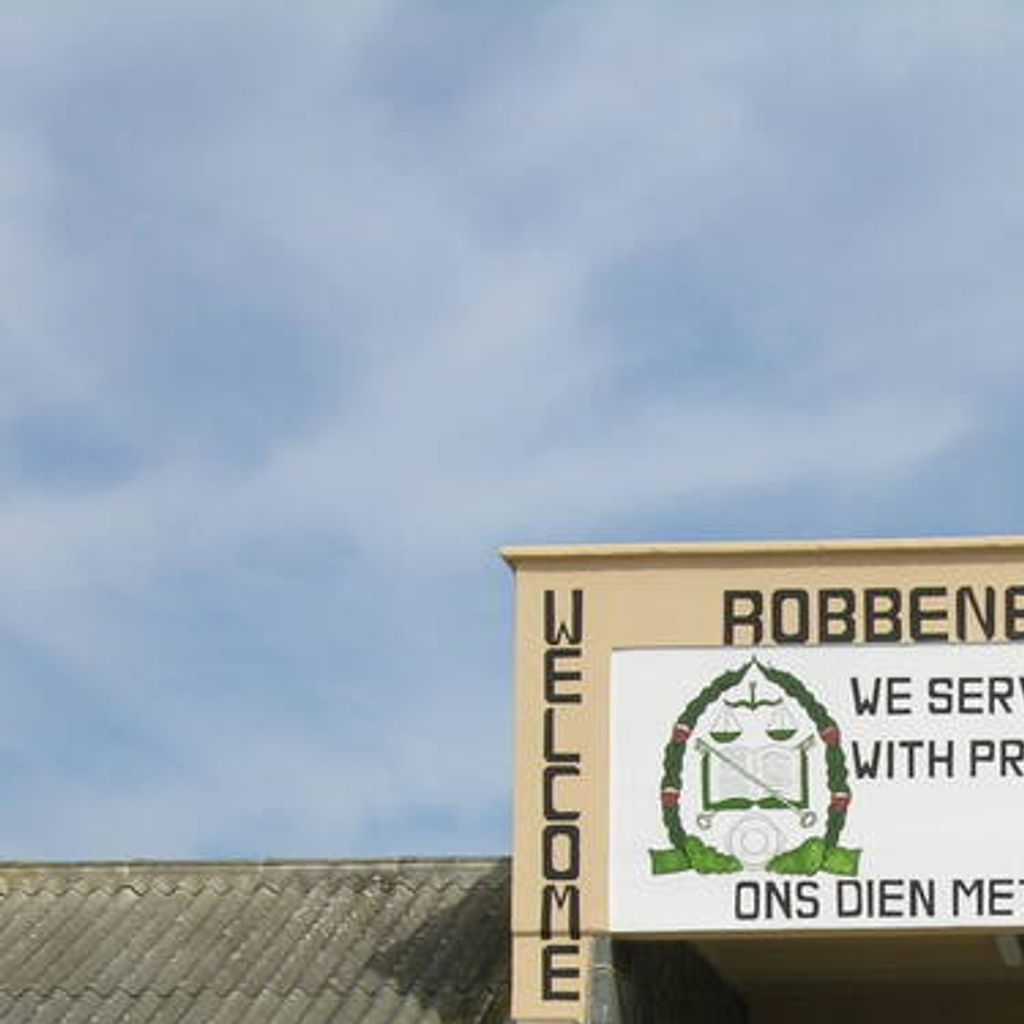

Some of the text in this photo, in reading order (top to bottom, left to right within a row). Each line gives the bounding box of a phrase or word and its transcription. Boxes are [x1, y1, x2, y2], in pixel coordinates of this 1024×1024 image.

[851, 677, 912, 715] WE
[852, 740, 955, 779] WITH
[540, 589, 583, 1001] WELCOME
[735, 881, 820, 920] ONS
[837, 879, 936, 918] DIEN
